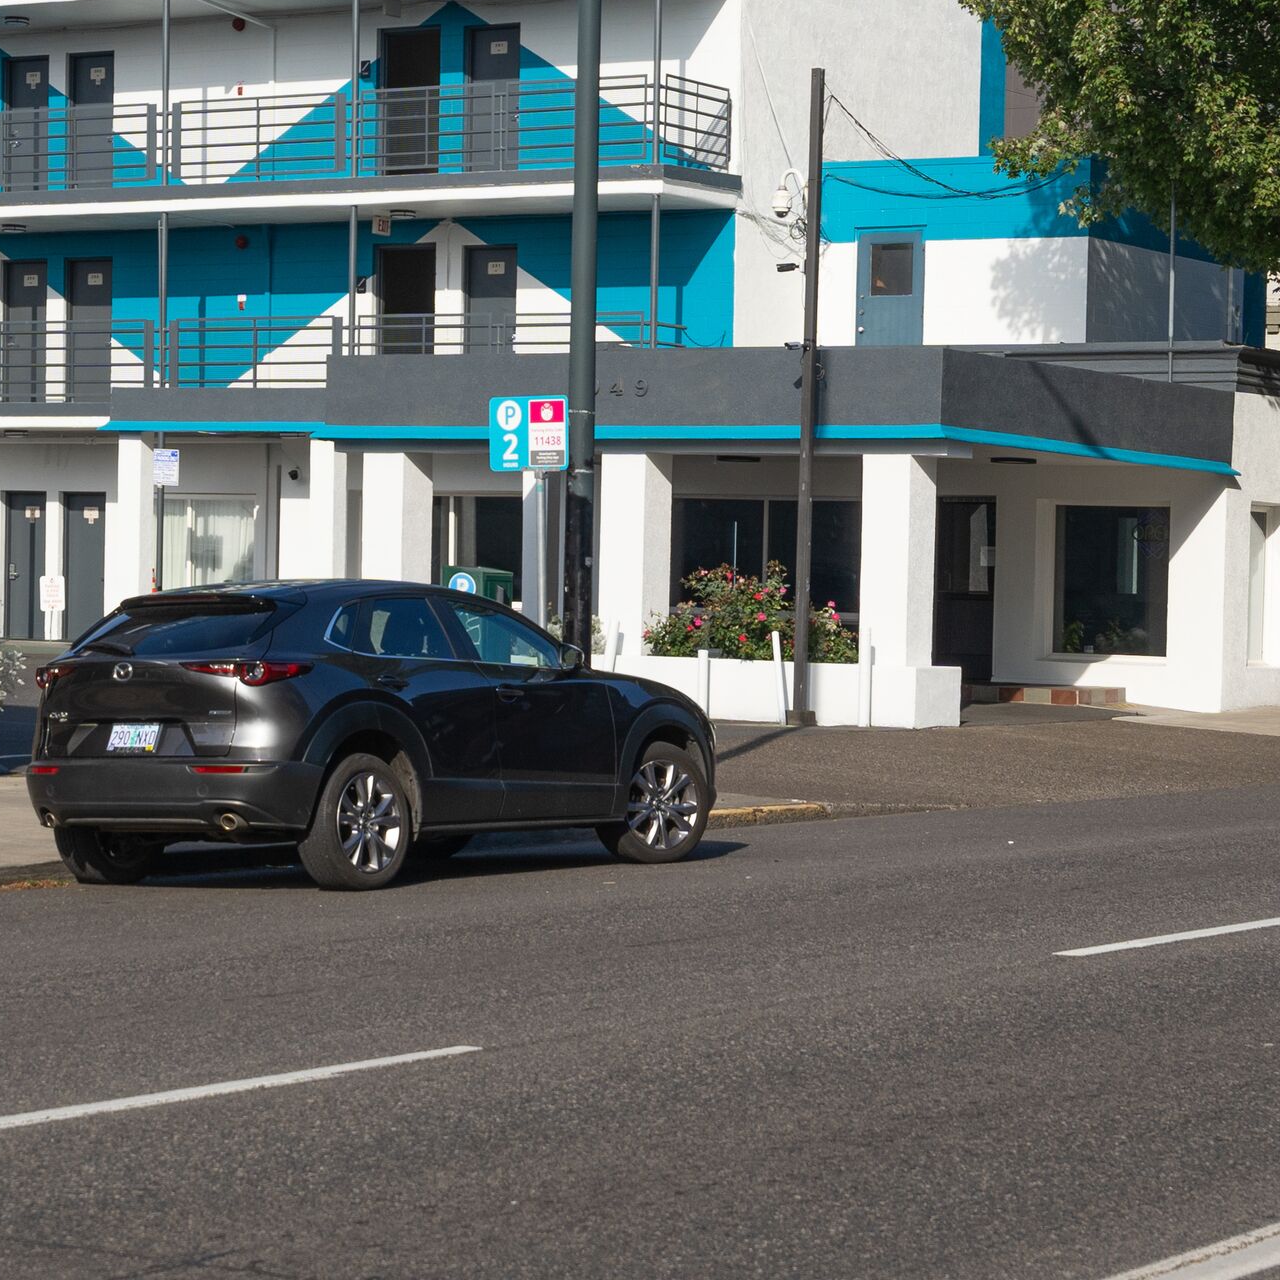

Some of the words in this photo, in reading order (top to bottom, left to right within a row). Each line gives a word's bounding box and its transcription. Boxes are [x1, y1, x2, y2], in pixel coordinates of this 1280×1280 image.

[505, 406, 516, 425] P
[503, 433, 519, 461] 2
[535, 436, 562, 446] 11438
[111, 730, 130, 745] 290
